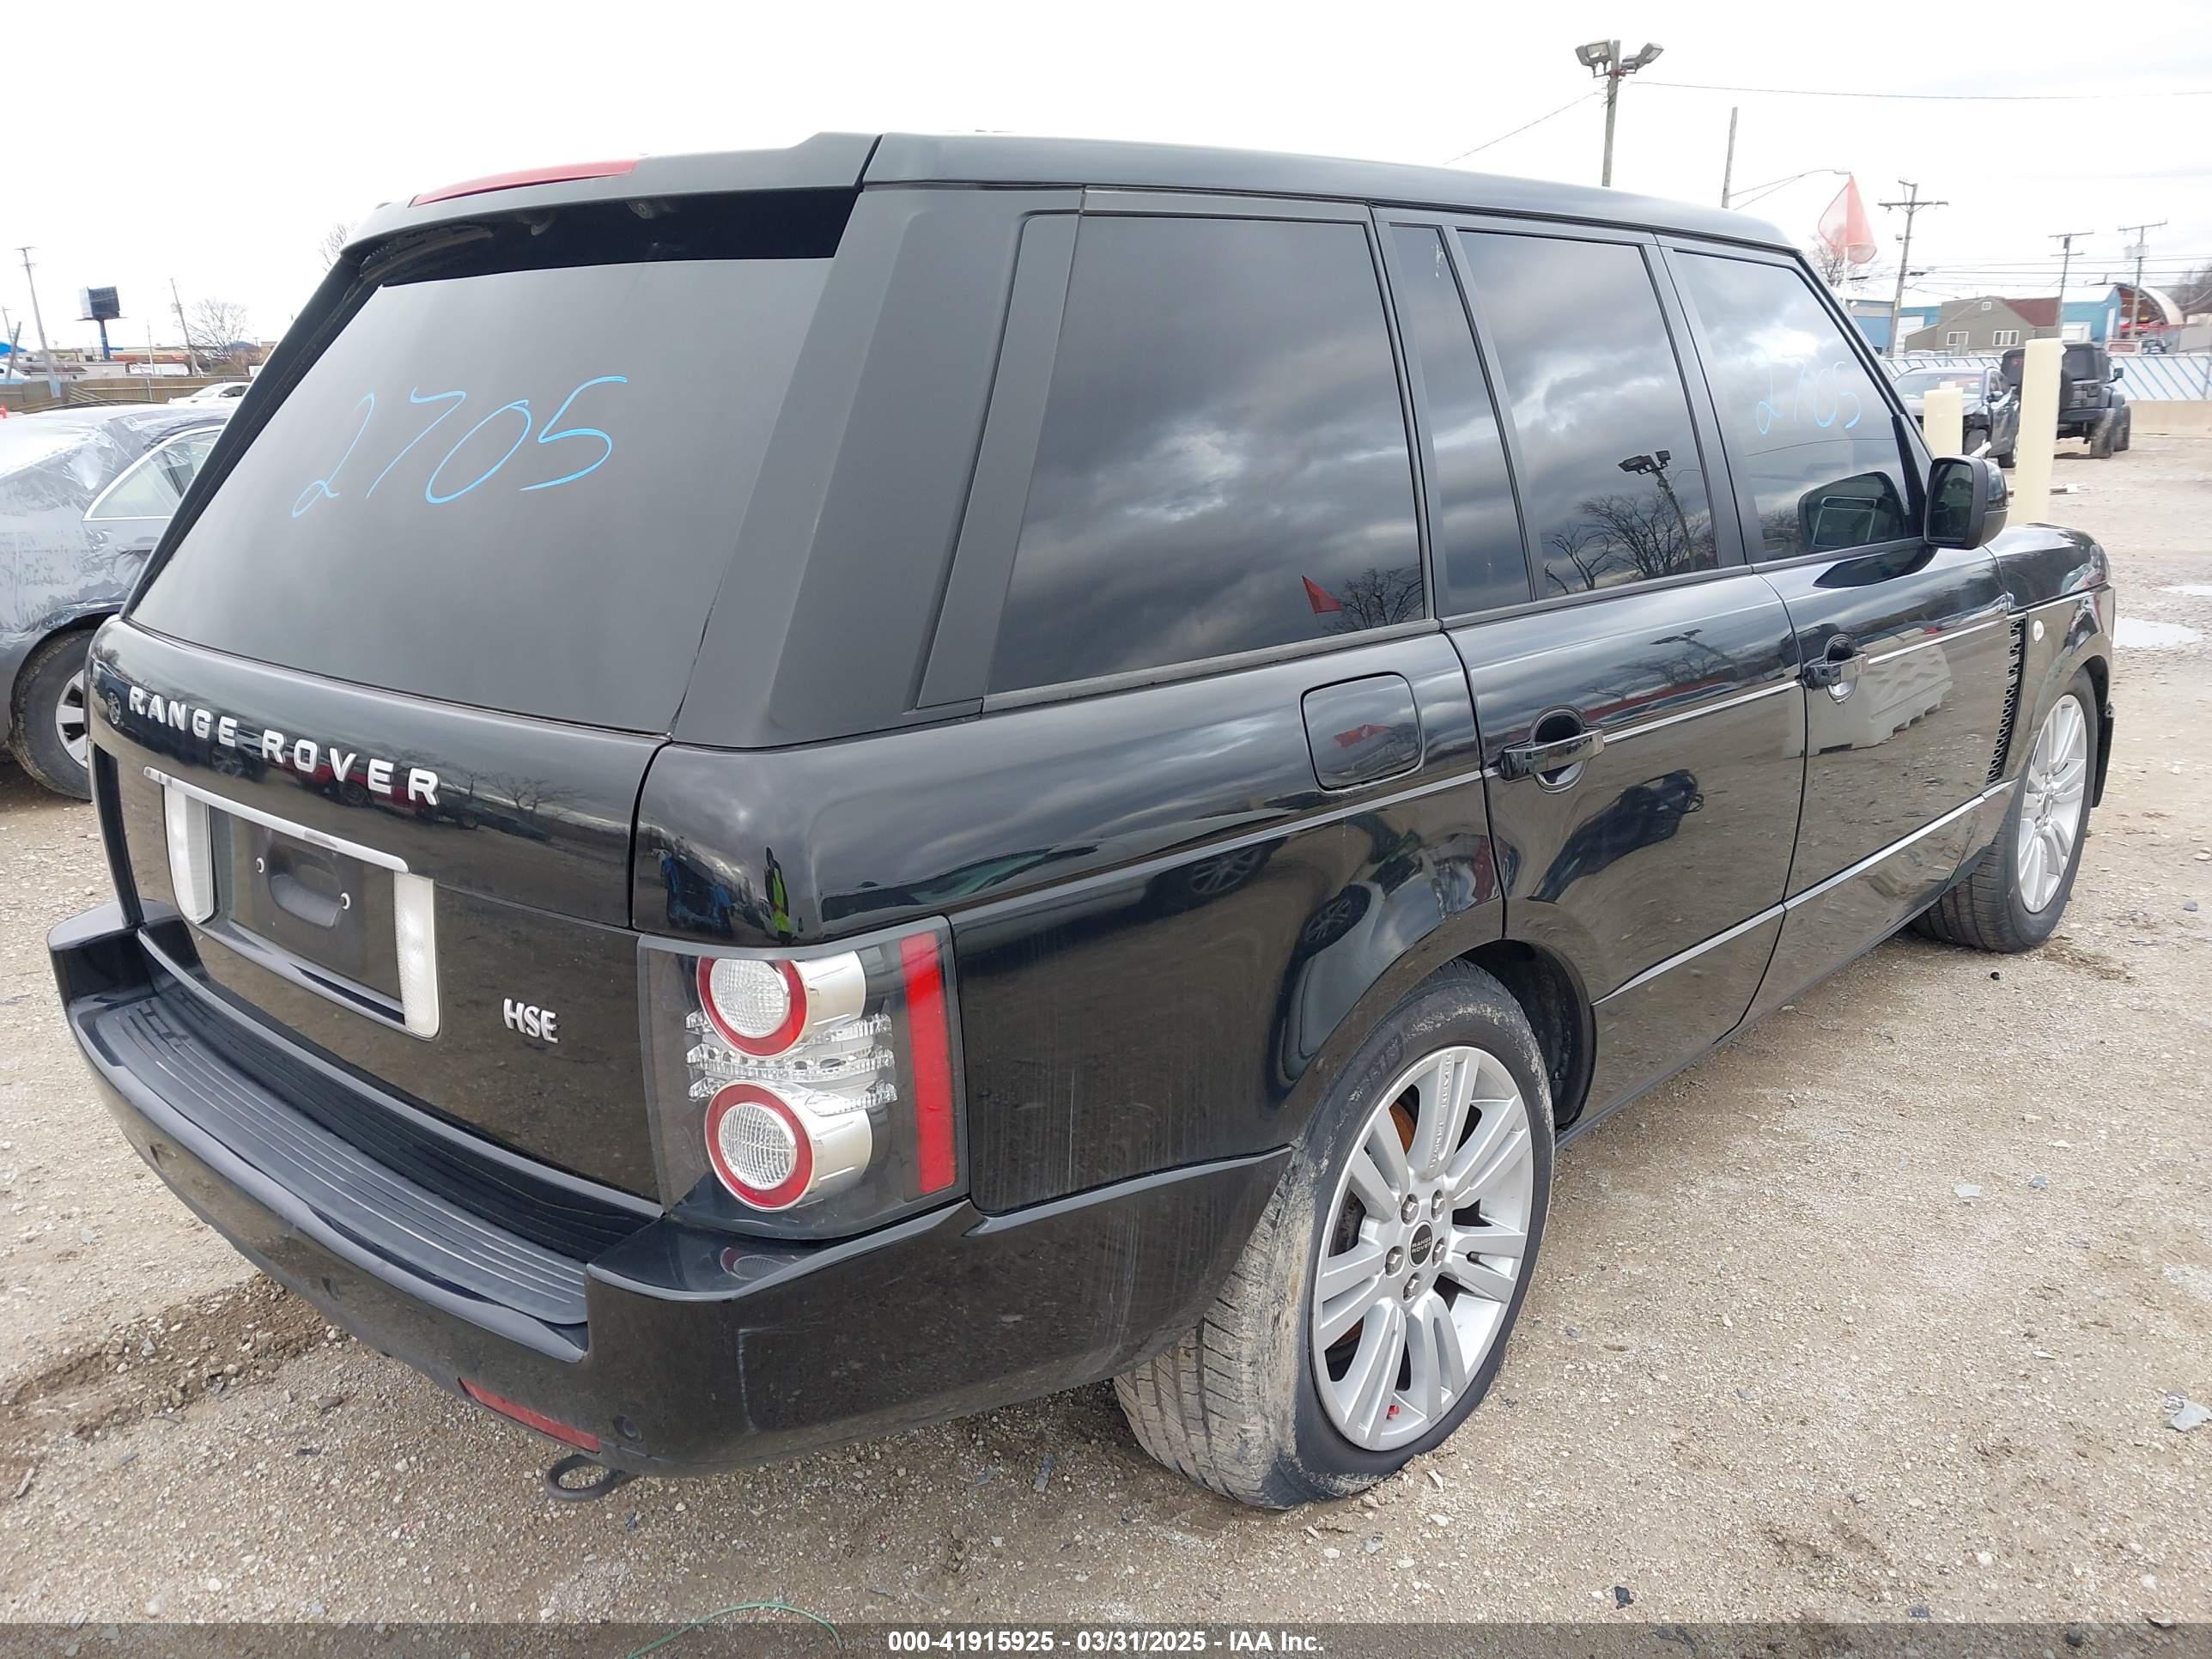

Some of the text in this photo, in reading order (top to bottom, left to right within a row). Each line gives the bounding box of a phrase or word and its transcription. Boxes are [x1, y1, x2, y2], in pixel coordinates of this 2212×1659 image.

[291, 375, 628, 519] 2705
[129, 685, 441, 806] RANGE ROVER
[503, 998, 559, 1044] HSE
